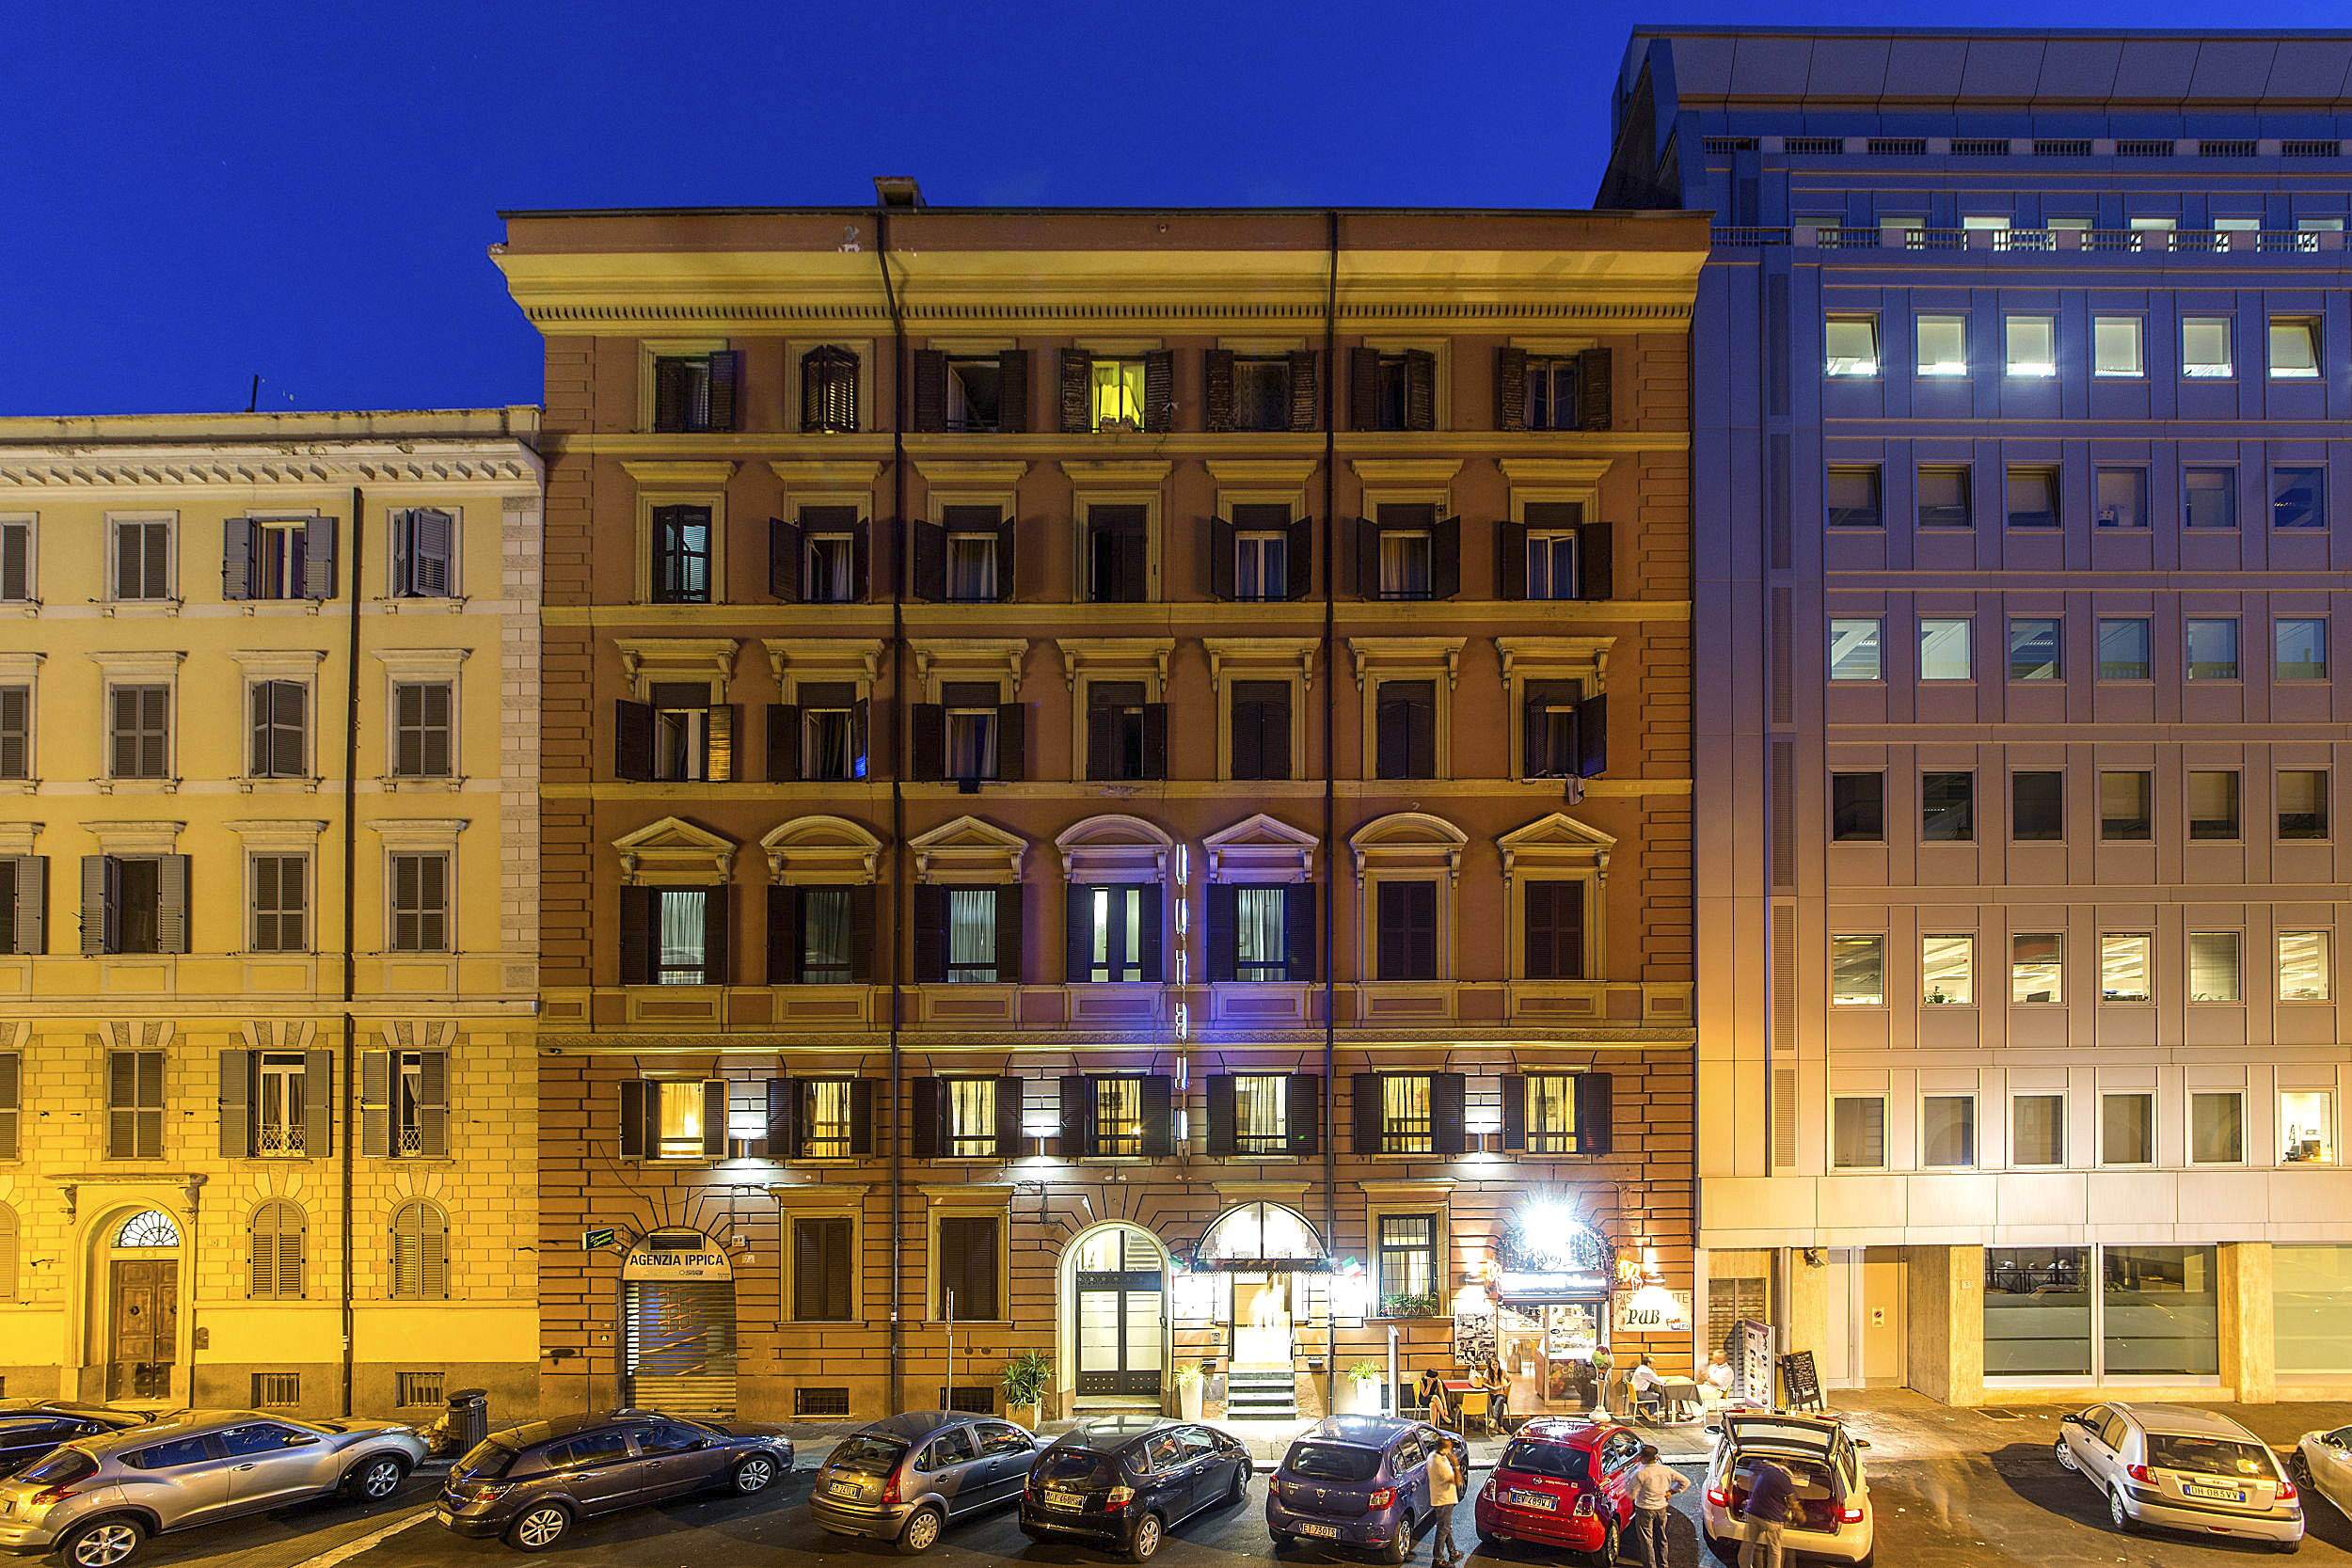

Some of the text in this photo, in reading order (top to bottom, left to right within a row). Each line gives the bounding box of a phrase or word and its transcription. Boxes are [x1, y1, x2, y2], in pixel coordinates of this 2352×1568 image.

[629, 1254, 723, 1266] AGENZIA IPPICA
[1517, 1495, 1526, 1503] EV
[1304, 1523, 1335, 1537] ET 730TS
